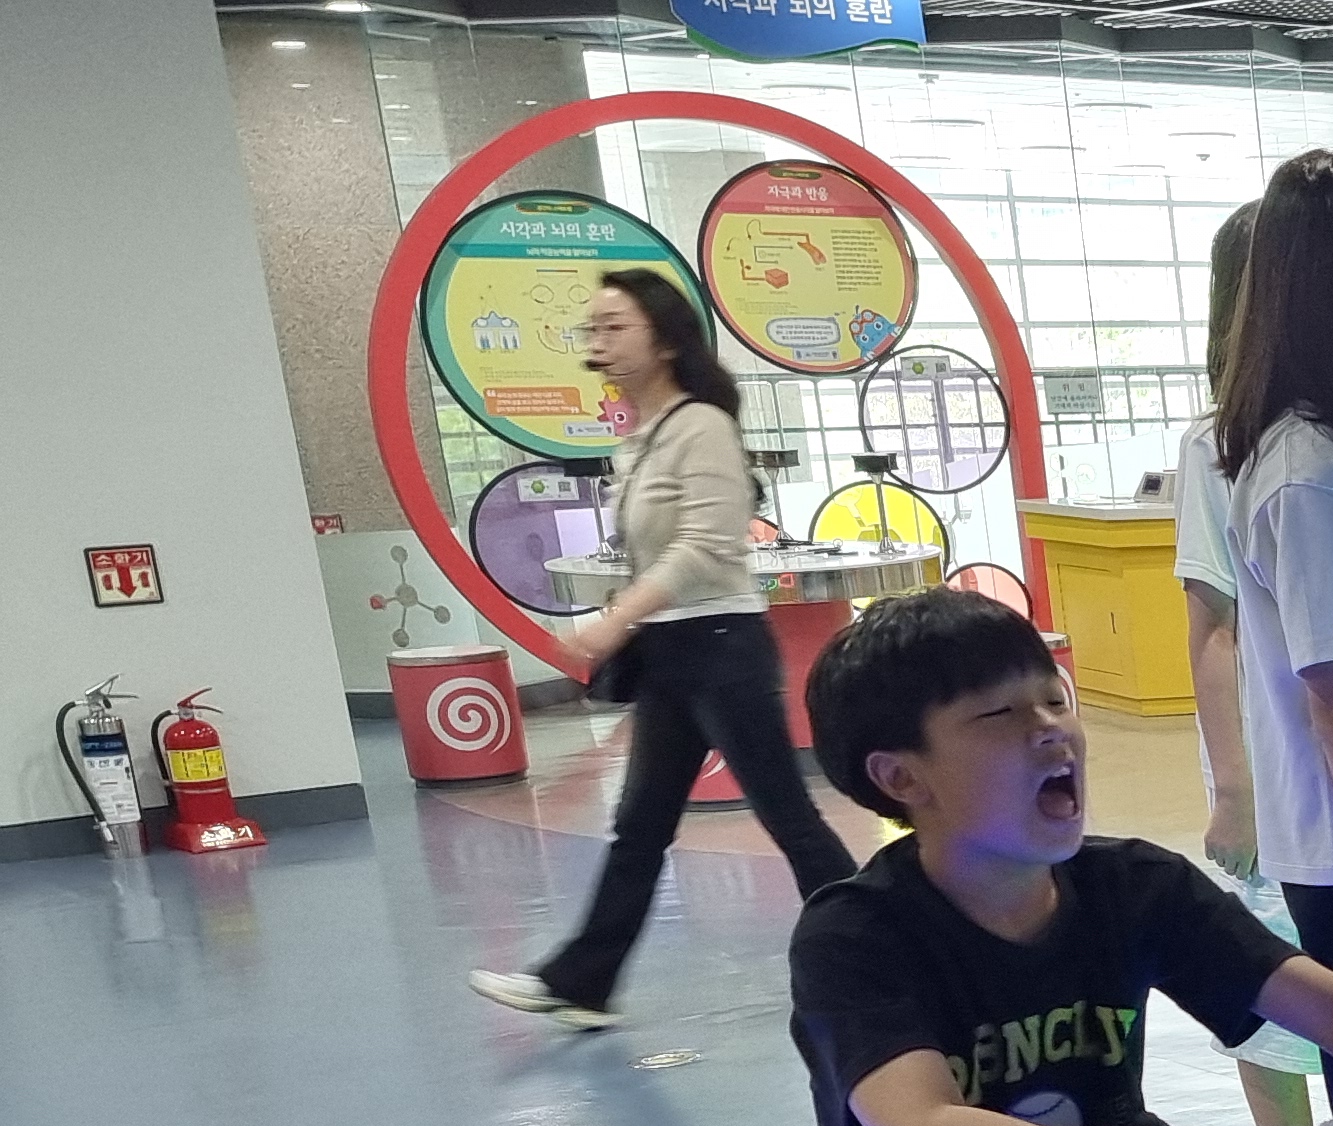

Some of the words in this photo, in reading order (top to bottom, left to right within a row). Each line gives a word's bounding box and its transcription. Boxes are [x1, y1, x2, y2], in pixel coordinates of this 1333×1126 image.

[846, 0, 893, 24] 혼란
[767, 185, 803, 199] 자극과
[805, 186, 829, 201] 반응
[500, 221, 546, 240] 시각과
[550, 222, 581, 239] 뇌의
[586, 224, 616, 241] 혼란
[95, 551, 148, 565] 소화기
